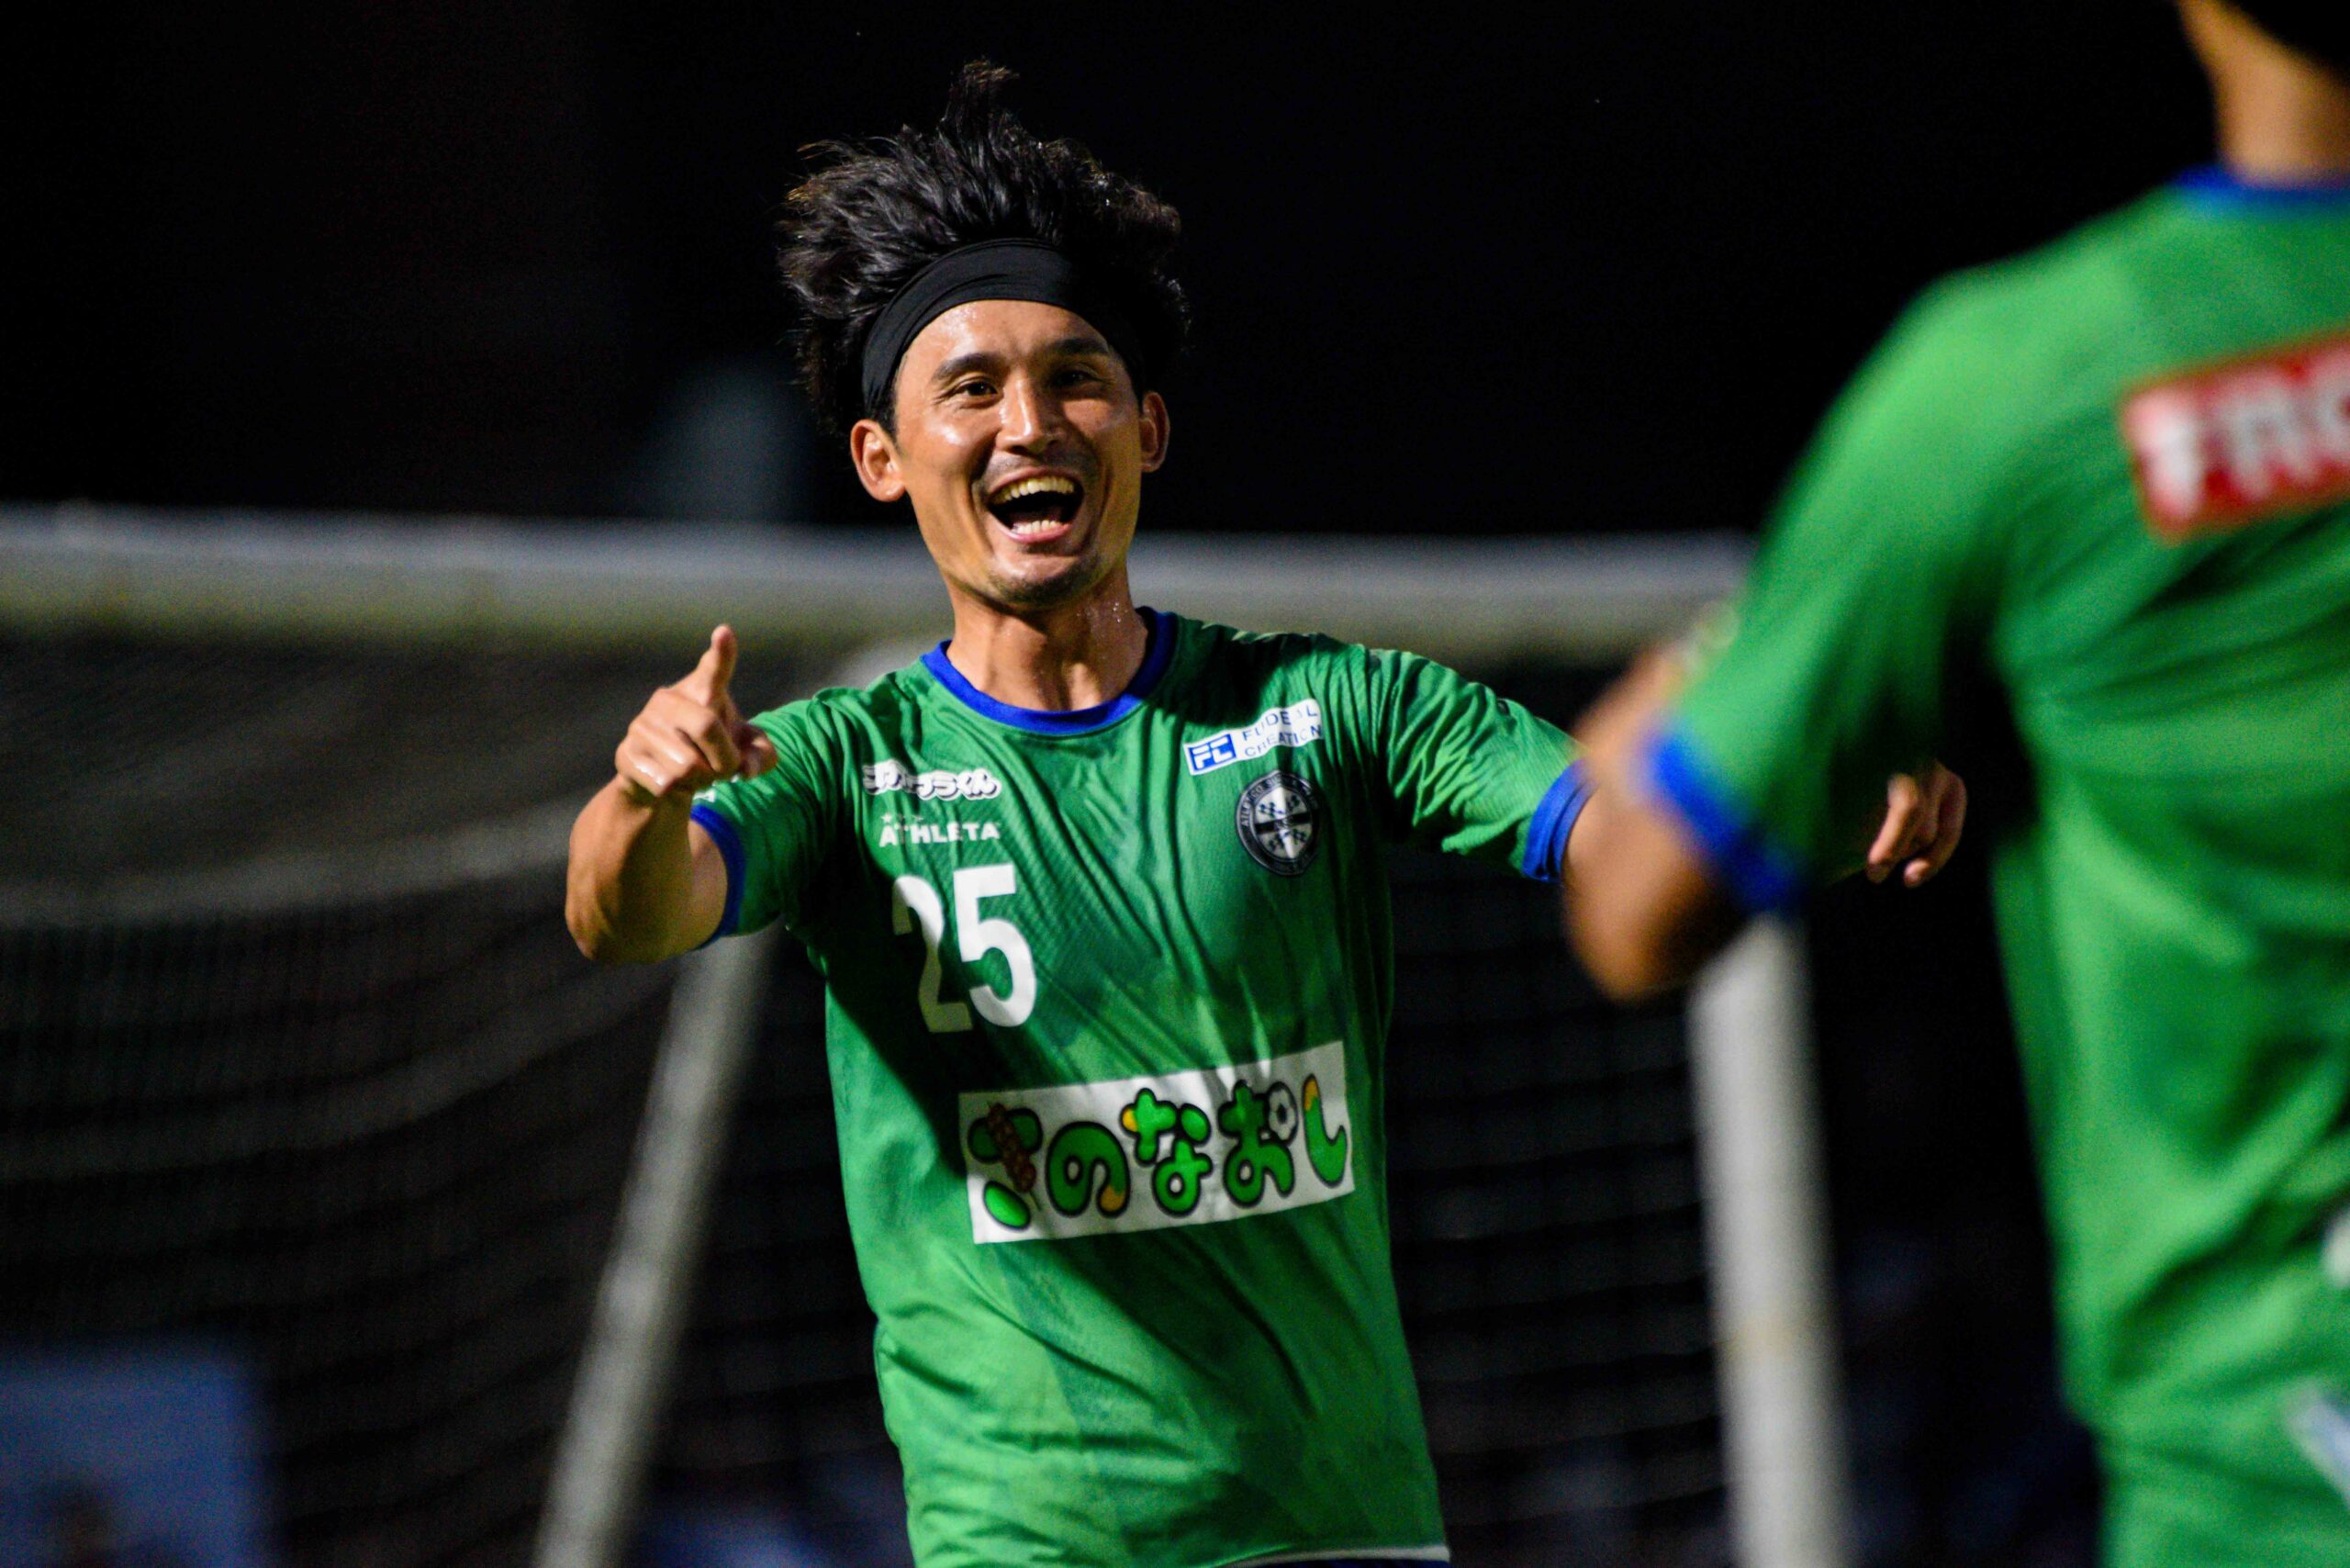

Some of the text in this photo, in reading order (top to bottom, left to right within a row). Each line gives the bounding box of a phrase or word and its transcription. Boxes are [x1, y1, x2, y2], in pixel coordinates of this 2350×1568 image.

[1242, 704, 1318, 741] FUDEL
[879, 822, 1000, 847] ATHLETA
[892, 863, 1036, 1032] 25
